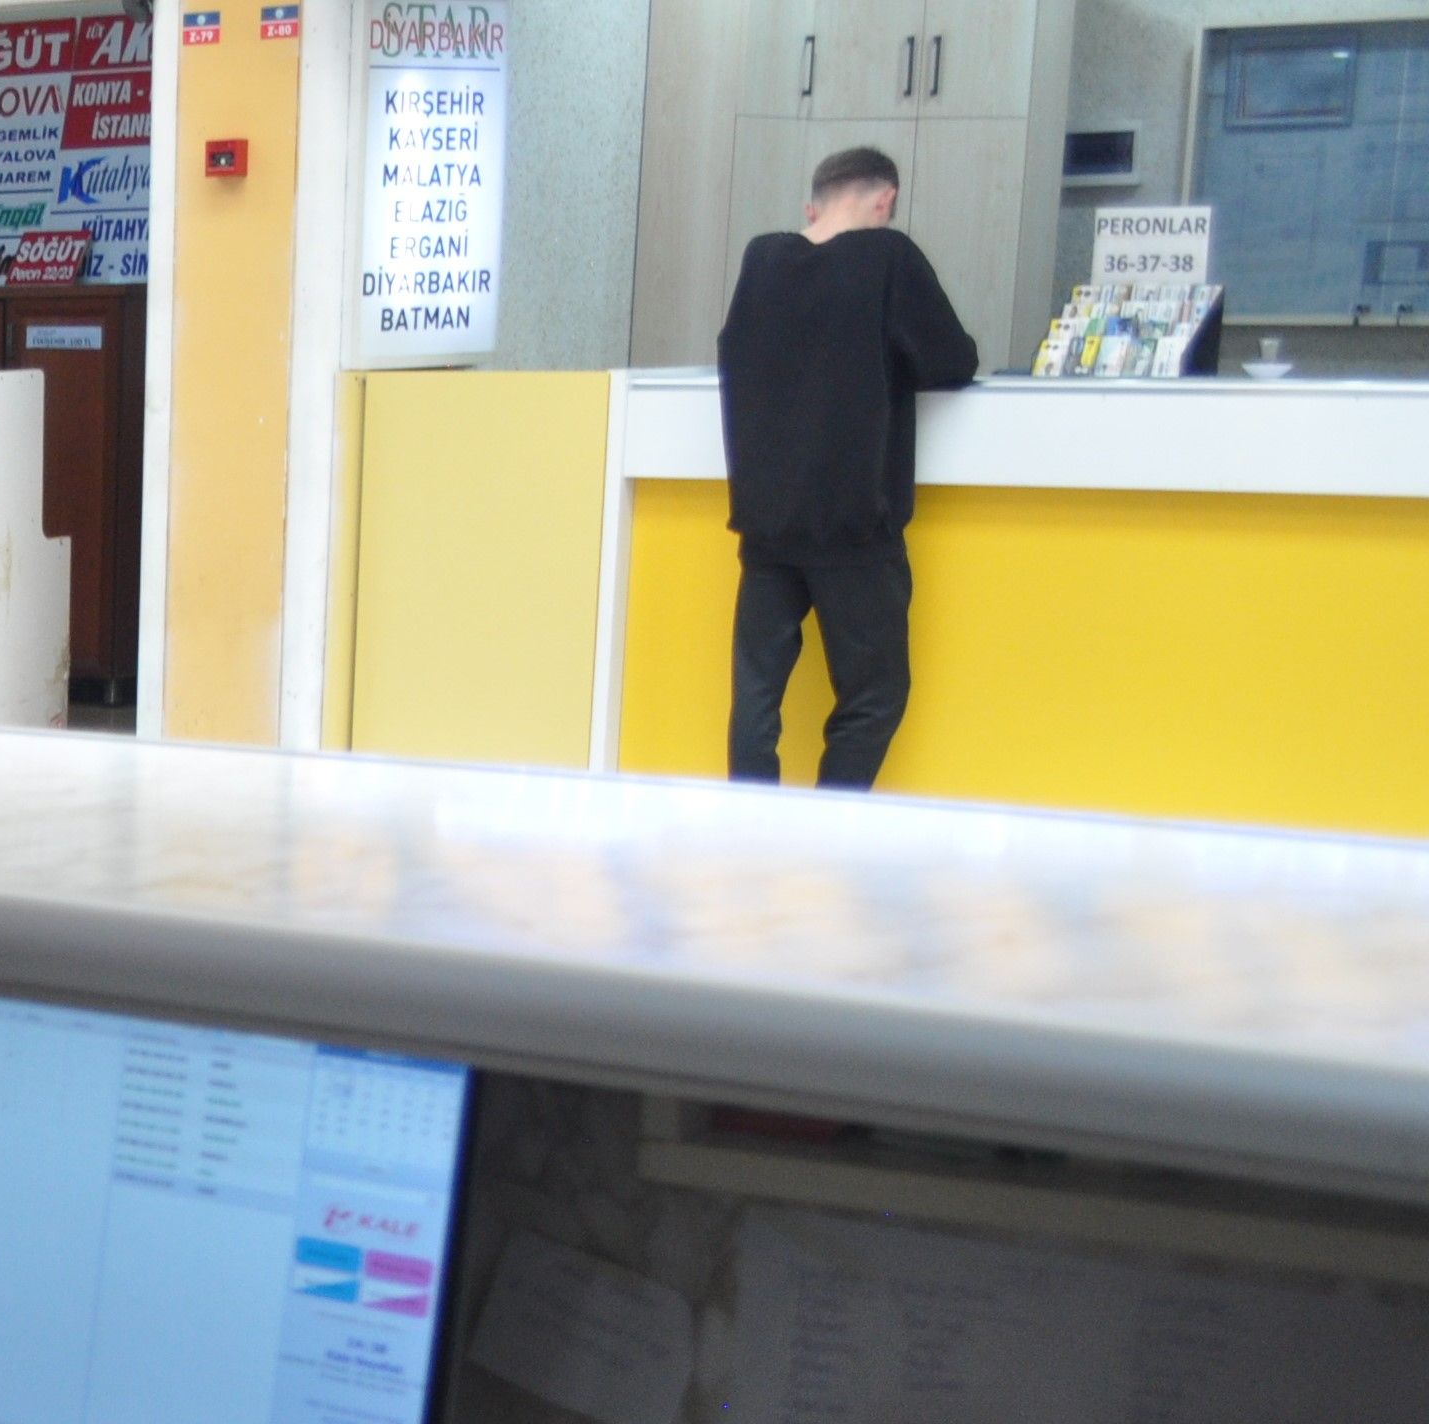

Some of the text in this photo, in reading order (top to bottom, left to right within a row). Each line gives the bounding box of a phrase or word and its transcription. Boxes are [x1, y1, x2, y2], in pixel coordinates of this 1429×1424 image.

[72, 80, 131, 107] KONYA
[385, 85, 485, 118] KIRŞEHİR
[388, 121, 479, 152] KAYSERİ
[382, 163, 482, 188] MALATYA
[394, 192, 468, 223] ELAZIĞ
[1097, 217, 1208, 236] PERONLAR
[16, 237, 86, 263] SÖĞÜT
[389, 228, 469, 259] ERGANİ
[1103, 254, 1195, 273] 36-37-38
[362, 265, 491, 297] DİYARBAKIR
[380, 305, 471, 332] BATMAN
